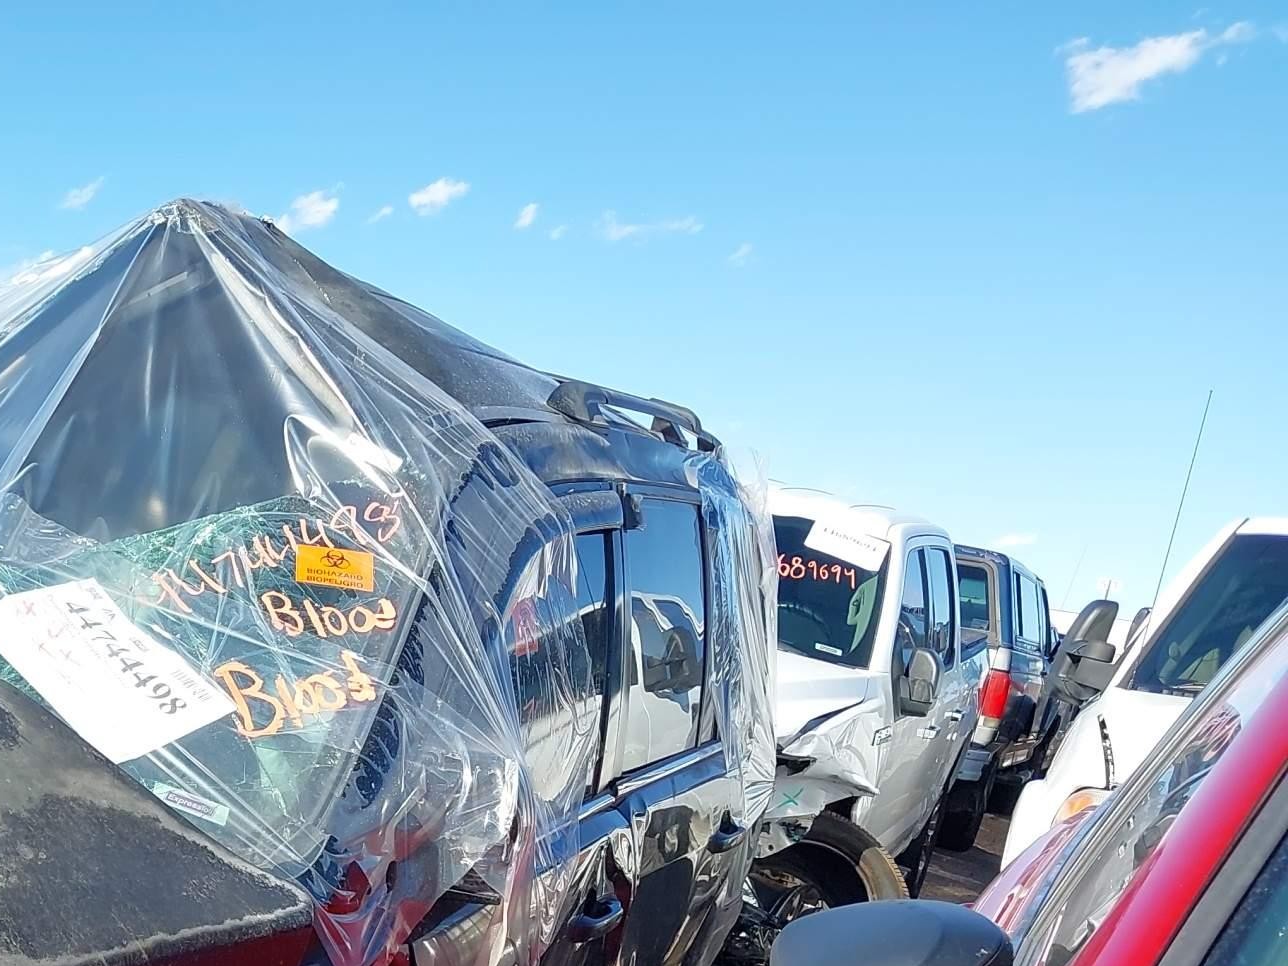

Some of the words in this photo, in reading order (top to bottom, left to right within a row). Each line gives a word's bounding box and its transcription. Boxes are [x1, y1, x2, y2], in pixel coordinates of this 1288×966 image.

[306, 567, 364, 581] BIOHAZARD
[306, 575, 364, 589] BIOPELIGRO
[65, 602, 188, 715] 44744498
